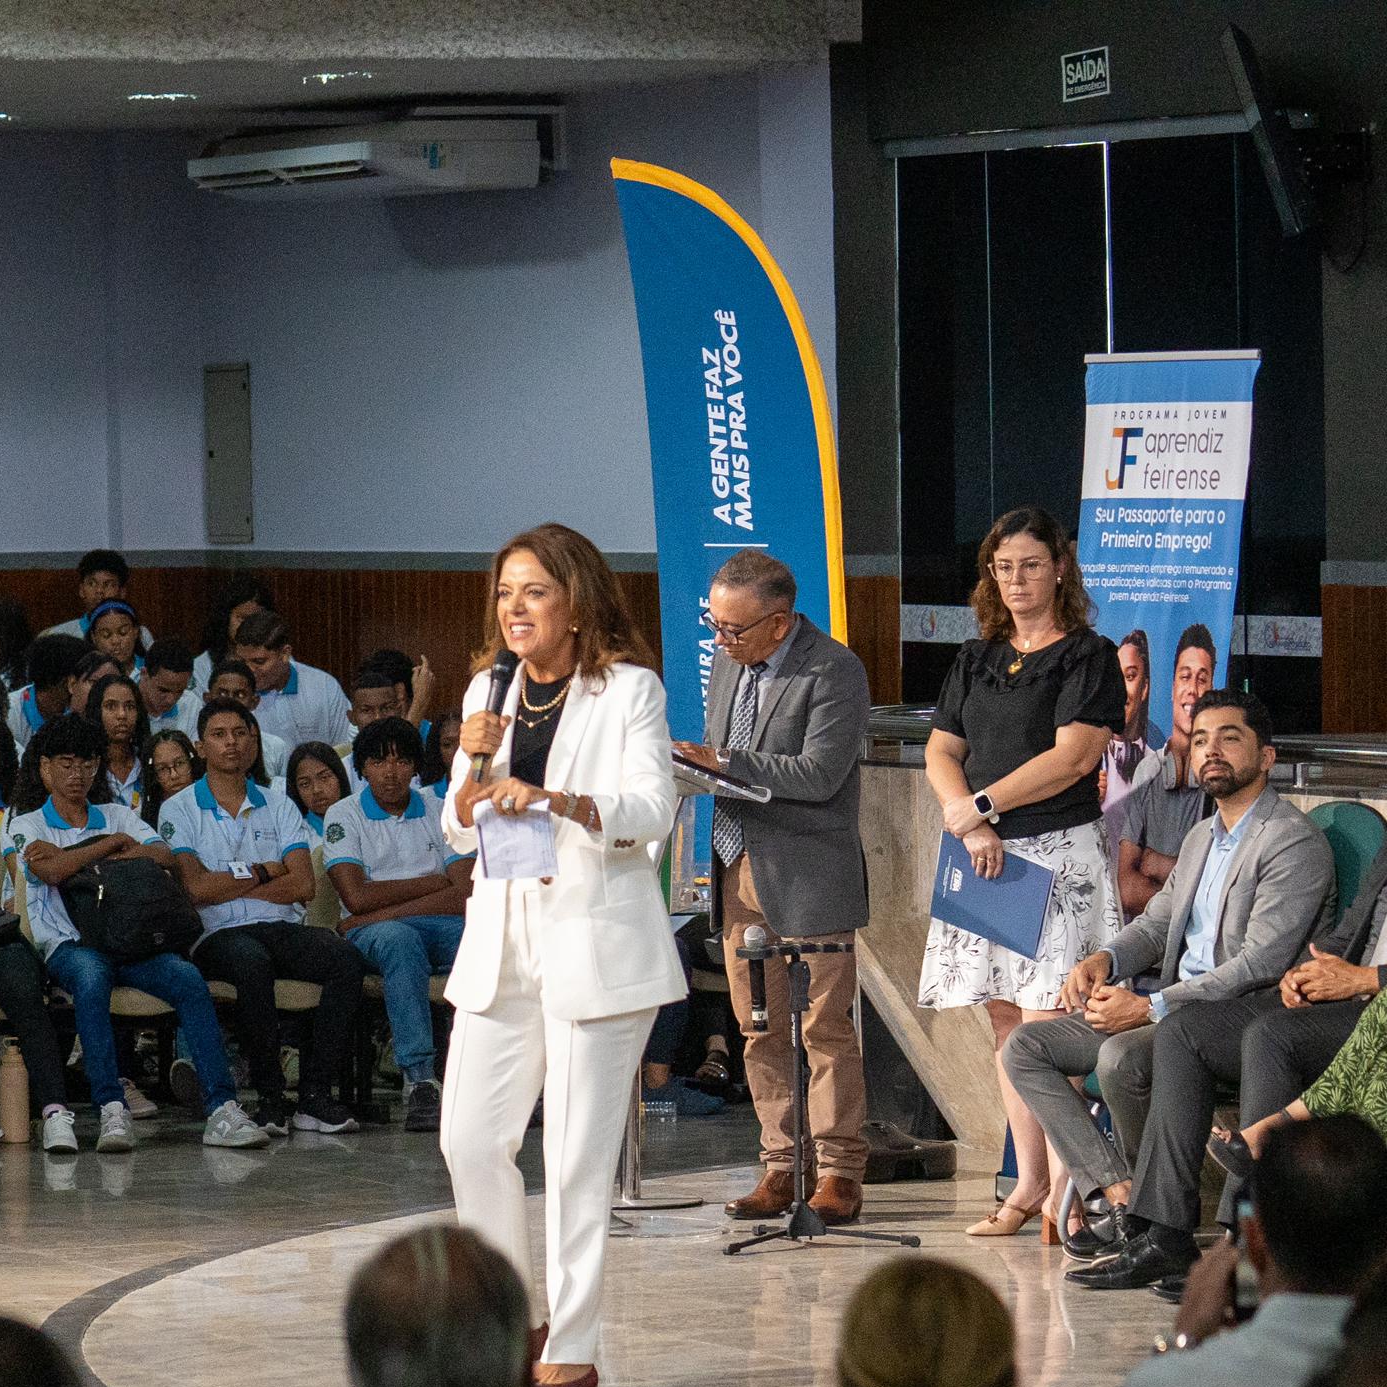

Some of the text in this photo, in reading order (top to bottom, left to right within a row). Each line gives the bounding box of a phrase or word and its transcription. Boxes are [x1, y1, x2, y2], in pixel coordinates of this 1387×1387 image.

[1066, 55, 1106, 84] SAÍDA
[714, 309, 754, 531] MAIS PRA VOCÊ
[1114, 410, 1227, 422] PROGRAMA JOVEM
[702, 347, 732, 526] A GENTE FAZ
[1145, 428, 1224, 458] aprendiz
[1143, 463, 1221, 490] feirense
[1095, 507, 1226, 526] Seu Passaporte para o
[1100, 530, 1212, 553] Primeiro Emprego!
[1120, 563, 1149, 574] primeiro
[1150, 565, 1182, 576] emprego
[1182, 565, 1226, 576] remunerado
[1228, 567, 1234, 576] e
[1173, 580, 1187, 588] com
[1188, 580, 1194, 589] o
[1194, 579, 1232, 591] Programa
[1107, 591, 1129, 603] Jovem
[1130, 592, 1159, 603] Aprendiz
